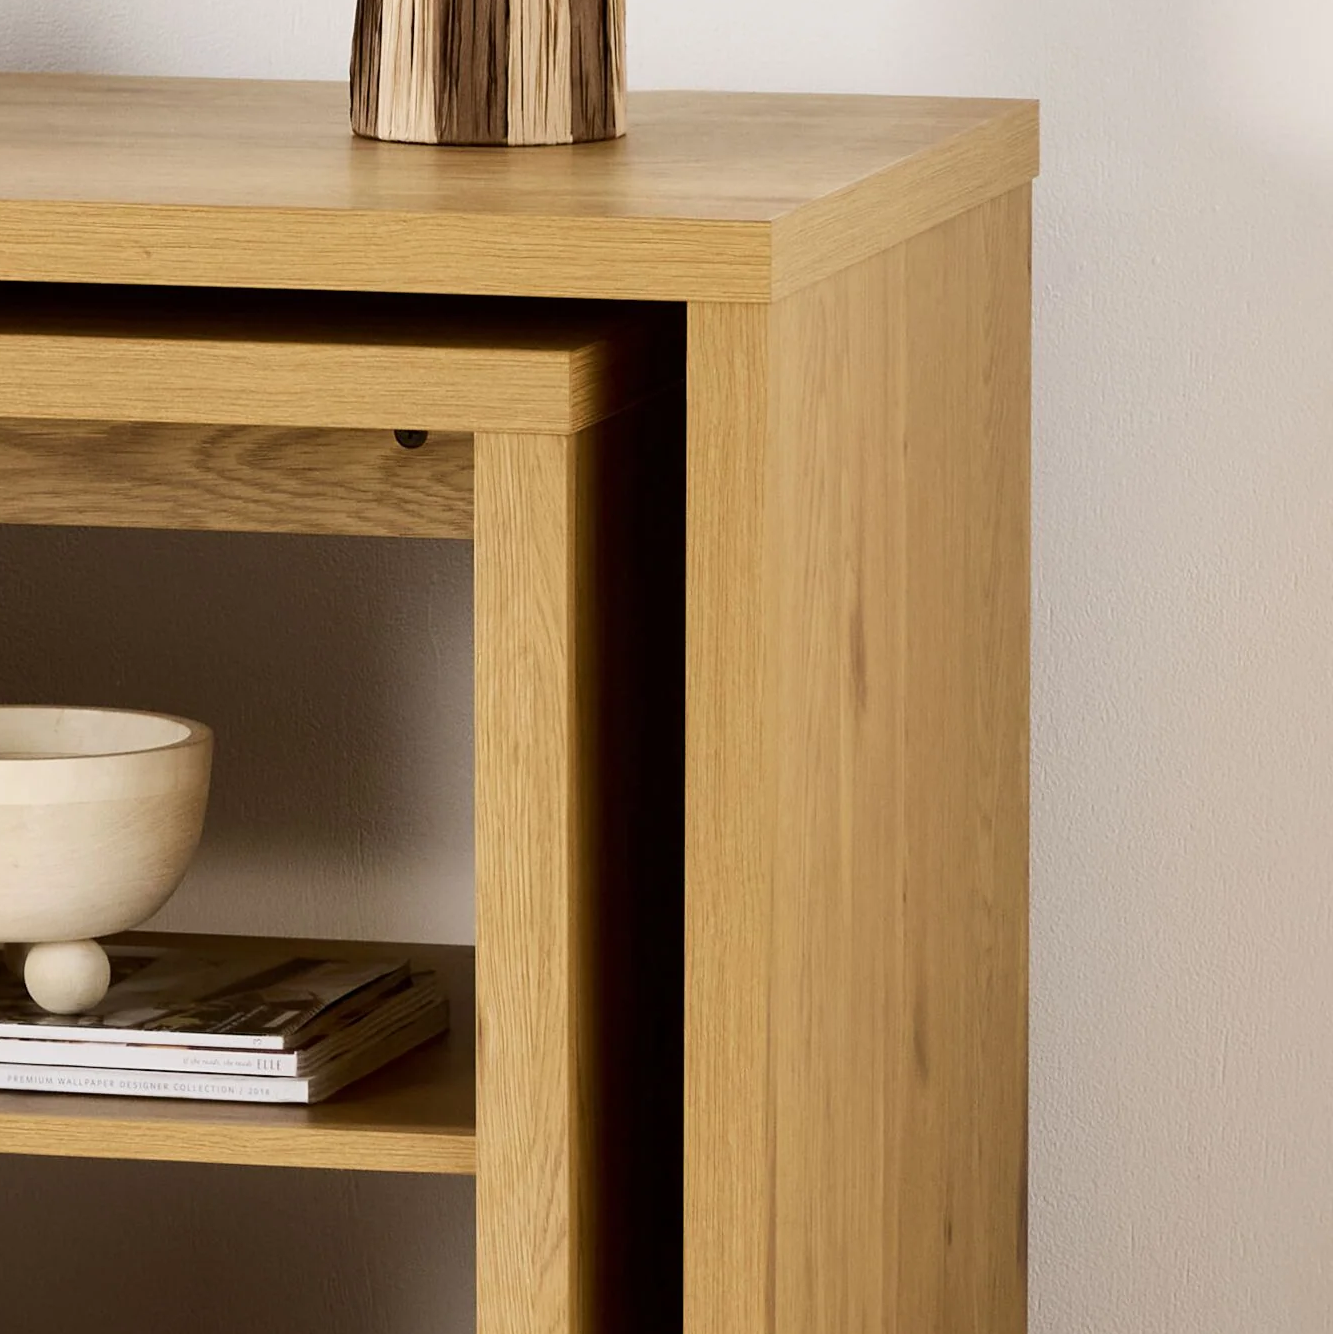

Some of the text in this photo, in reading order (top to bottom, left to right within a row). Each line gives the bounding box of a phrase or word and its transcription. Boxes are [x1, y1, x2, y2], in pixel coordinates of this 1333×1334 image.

[256, 1058, 282, 1071] ELLE
[7, 1074, 53, 1084] PREMIUM
[57, 1076, 115, 1088] WALLPAPER
[119, 1081, 169, 1091] DESIGNER
[173, 1083, 235, 1094] COLLECTION
